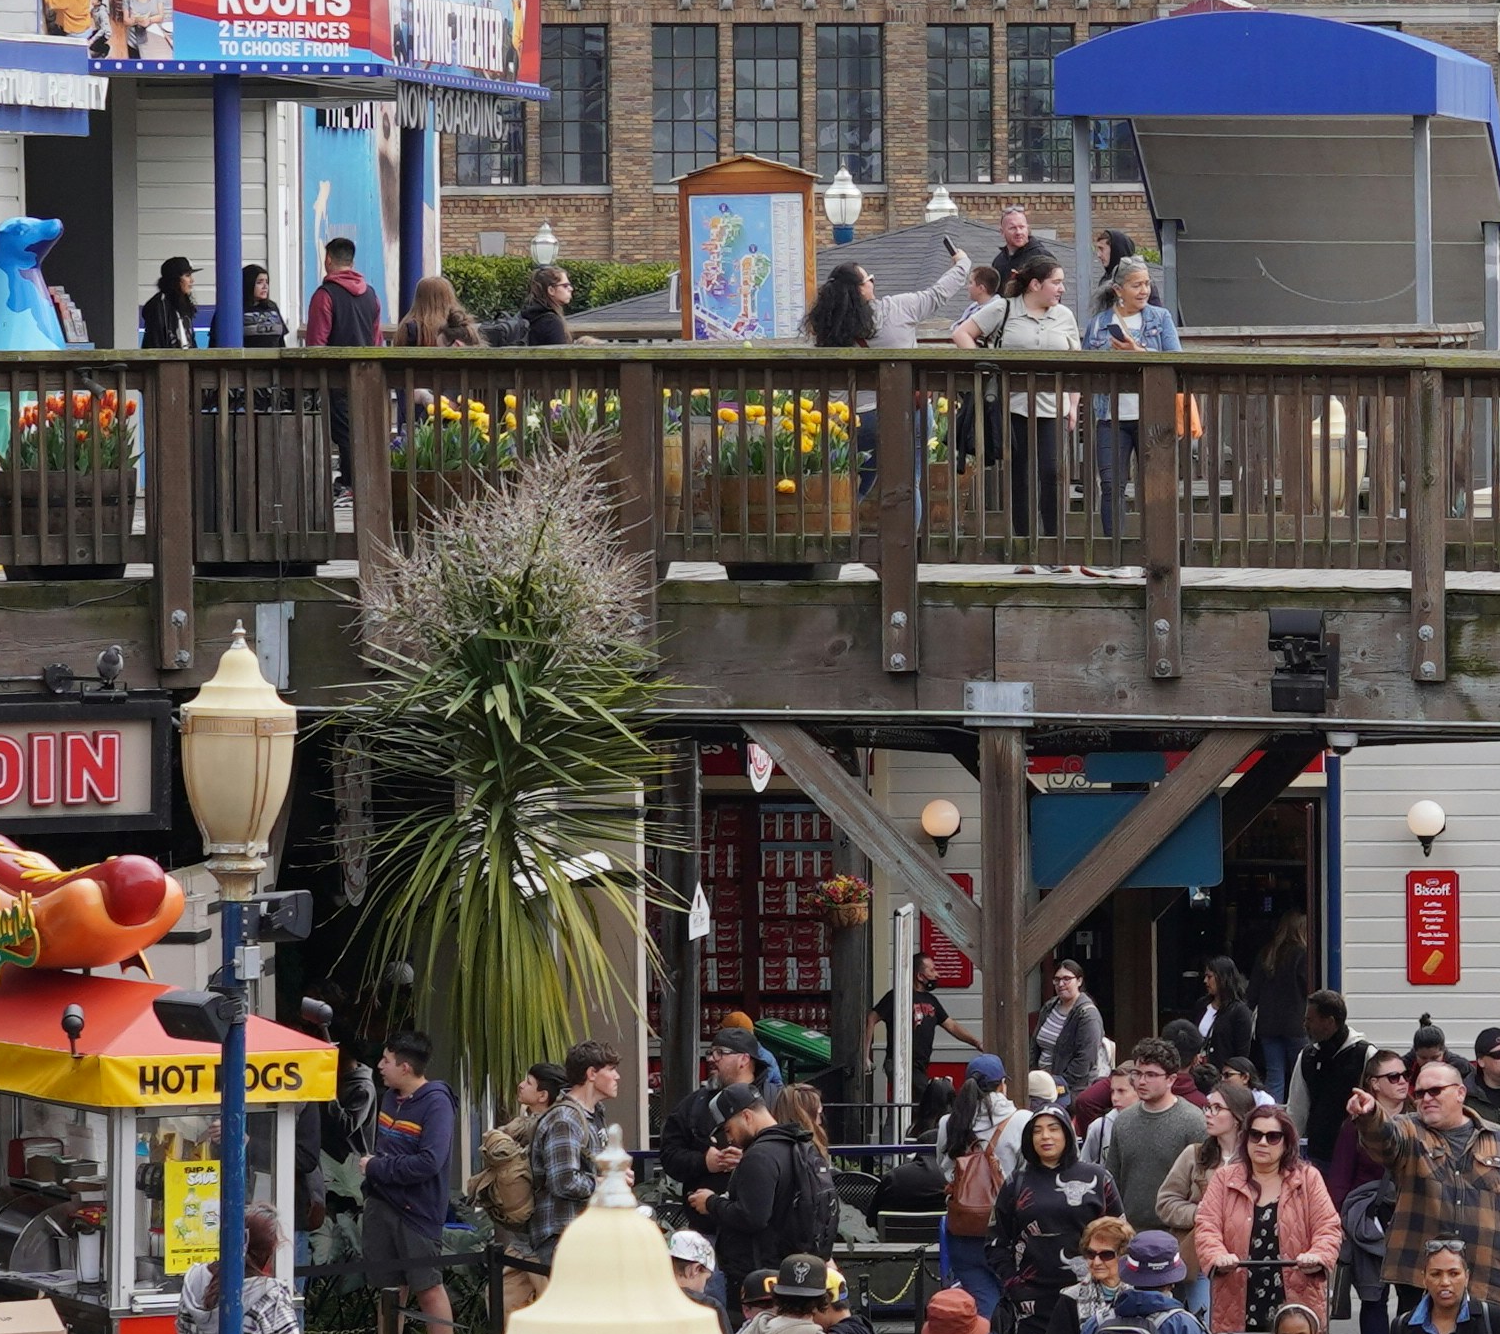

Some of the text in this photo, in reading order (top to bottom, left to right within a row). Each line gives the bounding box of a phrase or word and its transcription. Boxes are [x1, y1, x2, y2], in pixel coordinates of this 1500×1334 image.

[219, 20, 350, 39] 2 EXPERIENCES
[453, 3, 504, 72] THEATER
[219, 41, 350, 58] TO CHOOSE FROM!
[47, 73, 109, 111] REALITY
[399, 82, 504, 139] NOW BOARDING
[1414, 882, 1451, 896] Biscoff
[139, 1064, 205, 1095] HOT
[186, 1172, 219, 1186] SAVE
